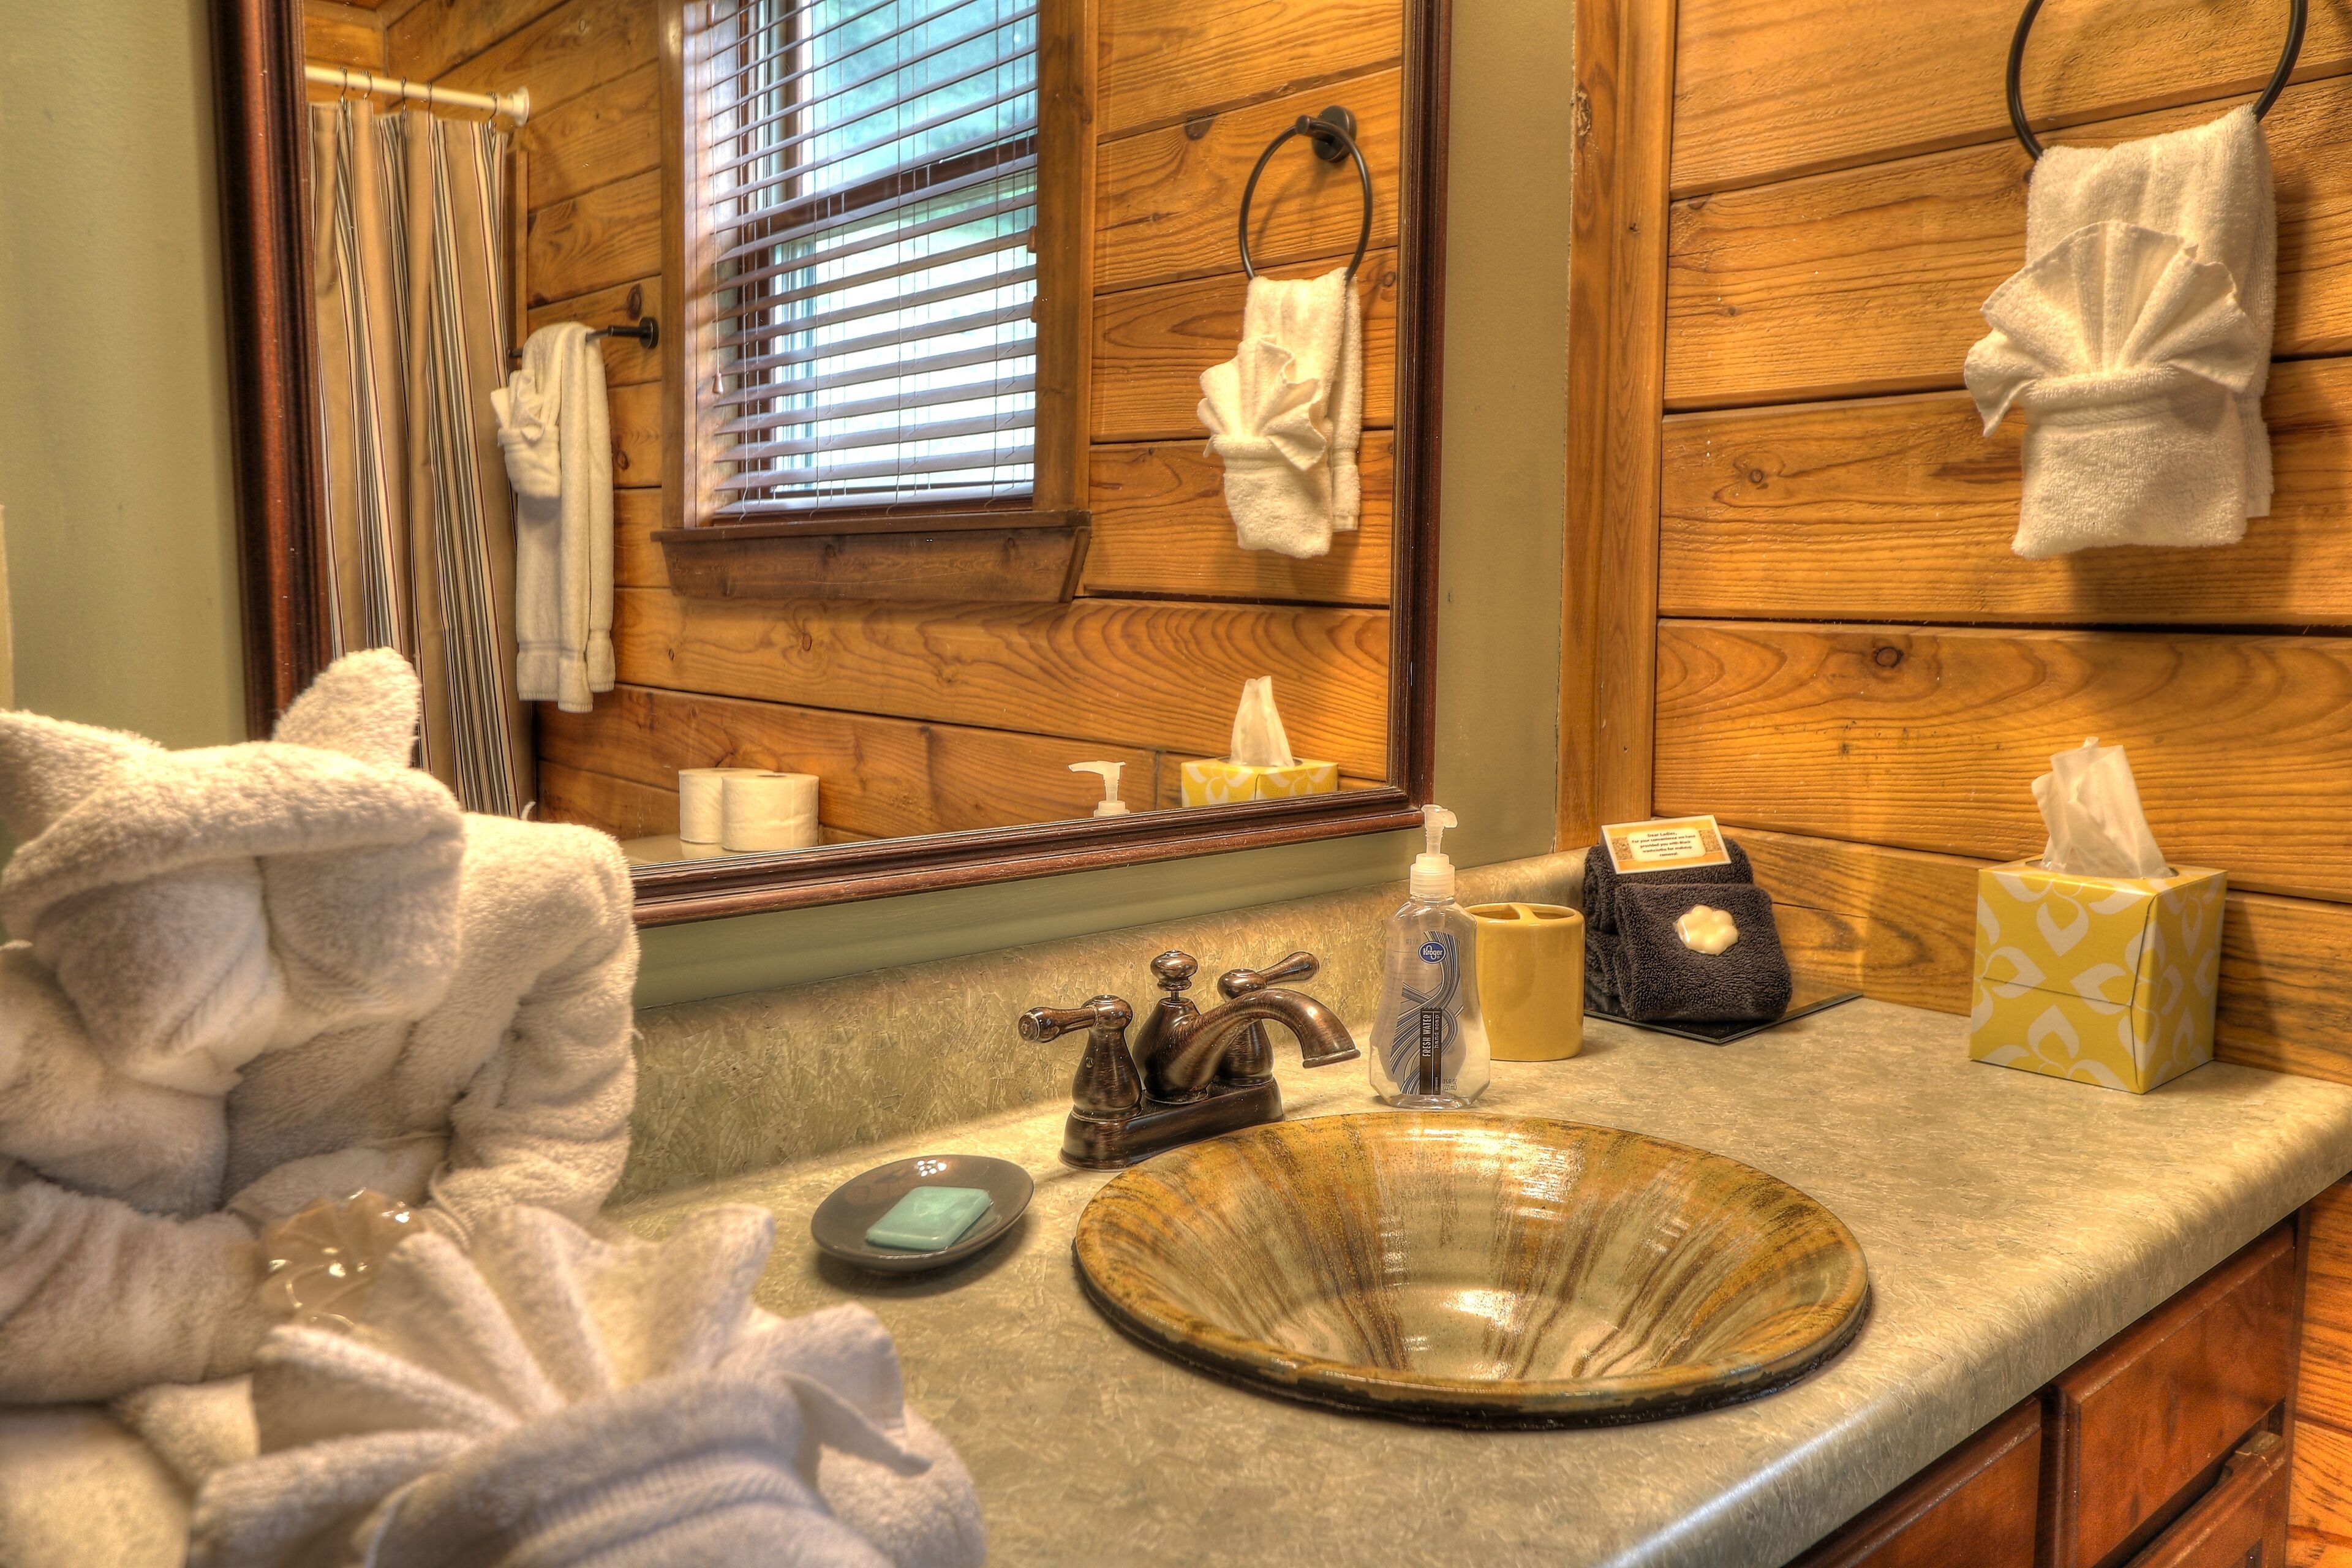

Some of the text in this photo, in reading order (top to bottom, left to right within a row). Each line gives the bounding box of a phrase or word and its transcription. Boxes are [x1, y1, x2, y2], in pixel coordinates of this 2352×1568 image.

[1423, 945, 1443, 960] Kroger
[1422, 1015, 1431, 1057] FRESH WATER
